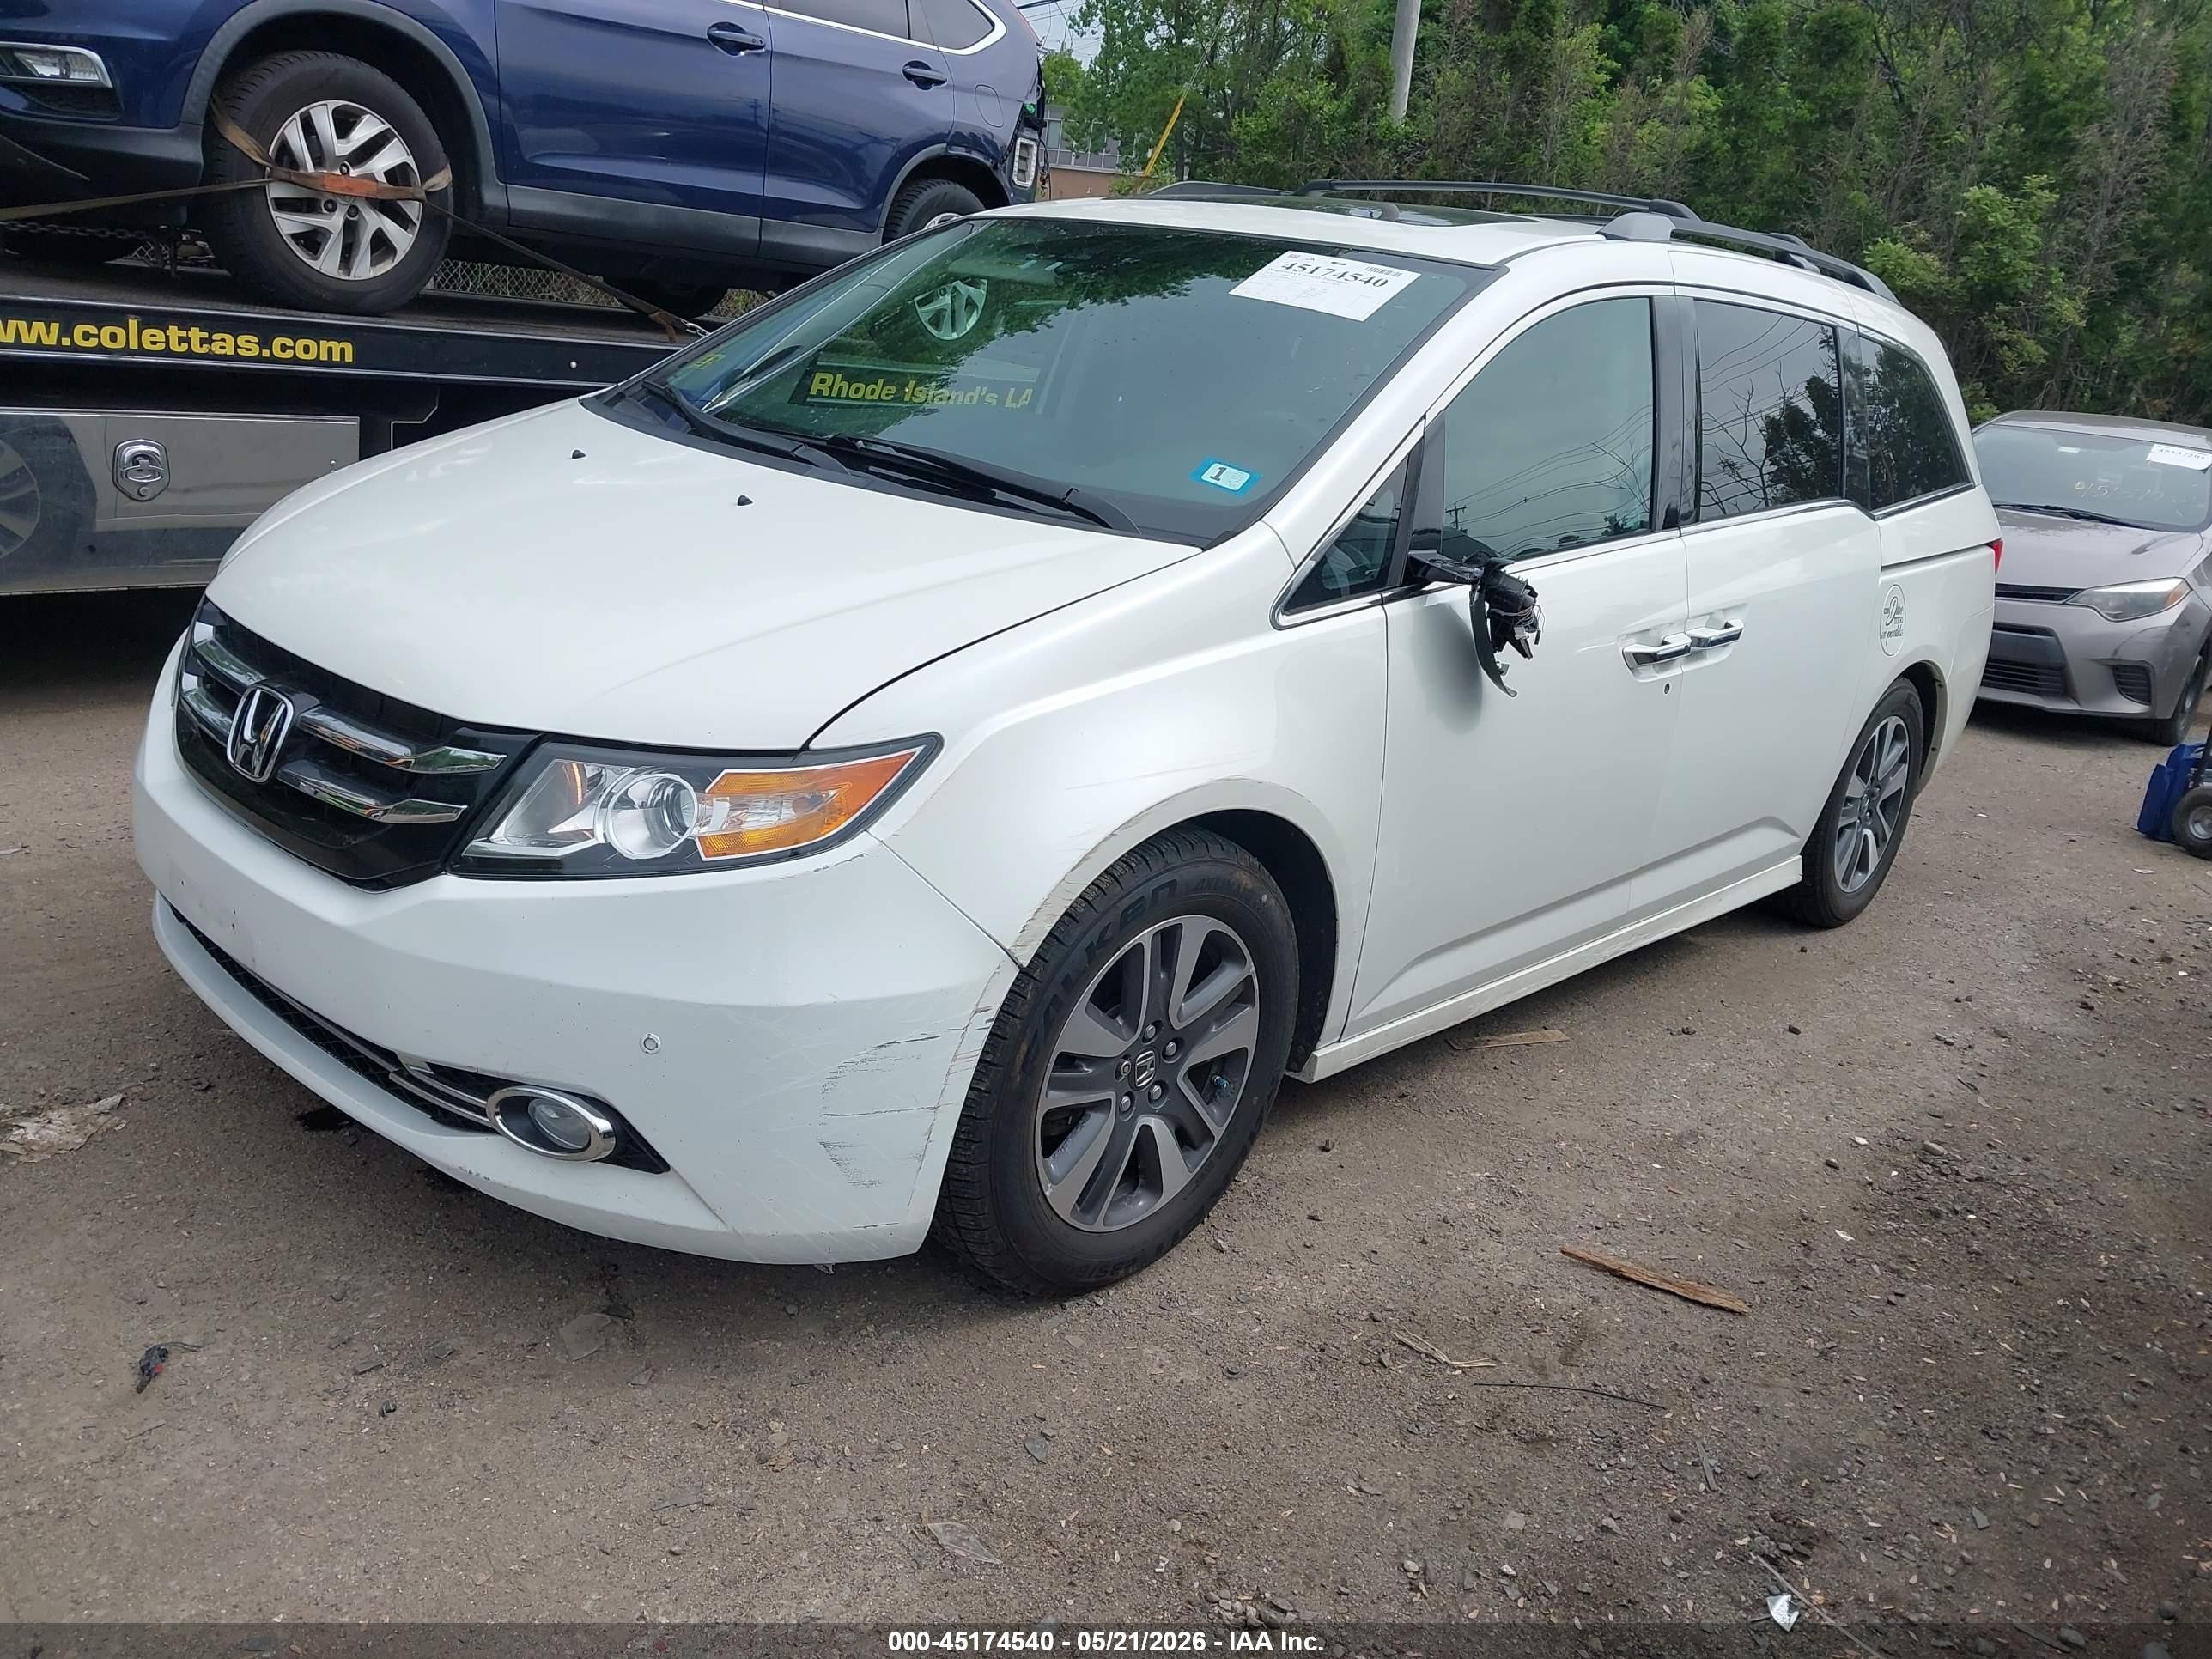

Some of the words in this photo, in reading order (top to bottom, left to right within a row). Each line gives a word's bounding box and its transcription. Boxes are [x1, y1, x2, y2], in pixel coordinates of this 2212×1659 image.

[1281, 261, 1389, 288] 45174540
[809, 372, 896, 401] Rhode
[904, 380, 998, 406] Island's
[1208, 466, 1227, 482] 1
